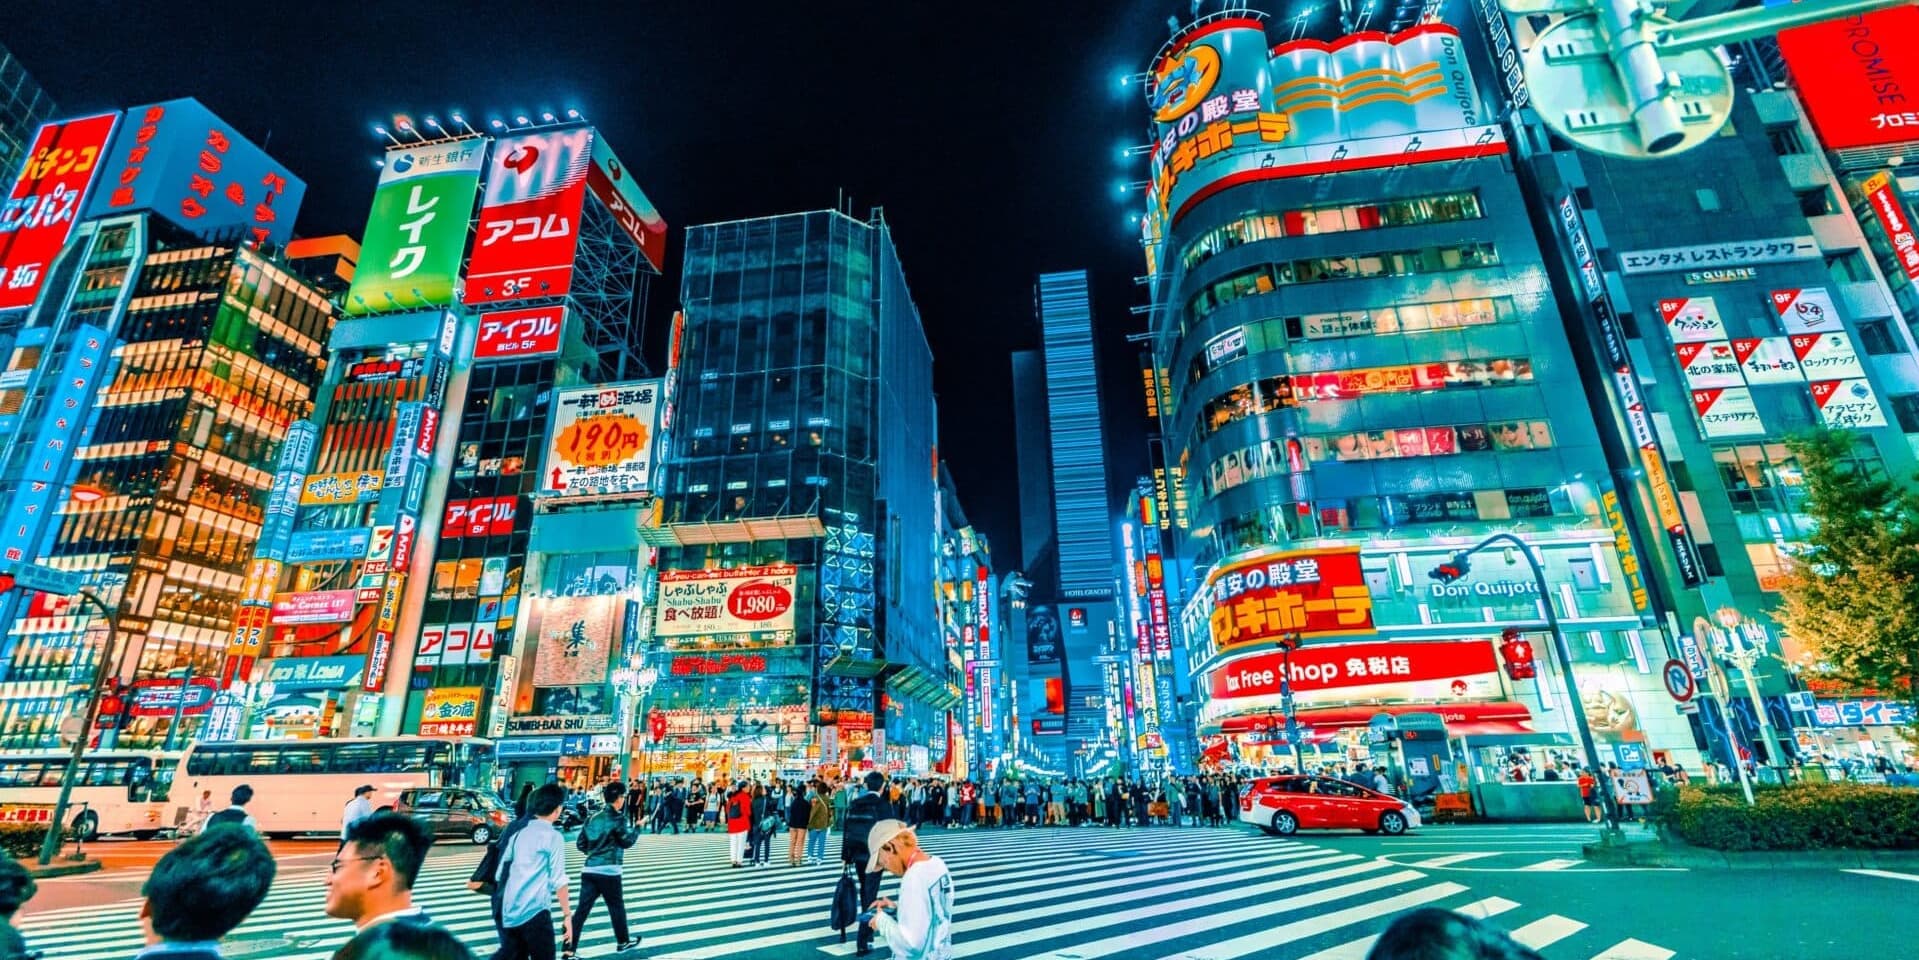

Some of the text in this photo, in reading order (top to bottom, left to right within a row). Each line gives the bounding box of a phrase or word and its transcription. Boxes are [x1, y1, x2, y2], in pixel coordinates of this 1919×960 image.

[1441, 37, 1476, 126] Don Quijote
[1870, 113, 1919, 129] プロミ
[19, 146, 97, 181] パチンコ
[419, 150, 472, 167] 新生銀行
[482, 213, 570, 246] アコム
[610, 191, 645, 246] アコム
[390, 185, 439, 279] レイク
[1626, 242, 1813, 268] エンタメ レストランタワー
[0, 263, 42, 289] 拓
[502, 277, 531, 296] 3F
[1661, 302, 1679, 313] 8F
[1774, 293, 1791, 303] 9F
[482, 317, 558, 341] アイフル
[1679, 346, 1696, 356] 4F
[1736, 342, 1752, 352] 5F
[1793, 338, 1810, 347] 6F
[1688, 363, 1739, 376] 北の家族
[1813, 385, 1830, 395] 2F
[570, 422, 639, 451] 190円
[448, 501, 516, 525] アイフル
[664, 583, 728, 597] しゃぶしゃぶ
[1432, 580, 1541, 599] Don Quijote
[664, 606, 724, 621] 食べ放題!
[736, 594, 776, 616] 1,980
[978, 582, 988, 628] SHIDAX
[420, 628, 493, 653] アコム
[1241, 669, 1274, 689] Free
[1279, 659, 1337, 684] Shop
[1346, 656, 1411, 677] 免税店
[438, 701, 475, 718] 金の蔵
[1842, 701, 1917, 724] ダイコ
